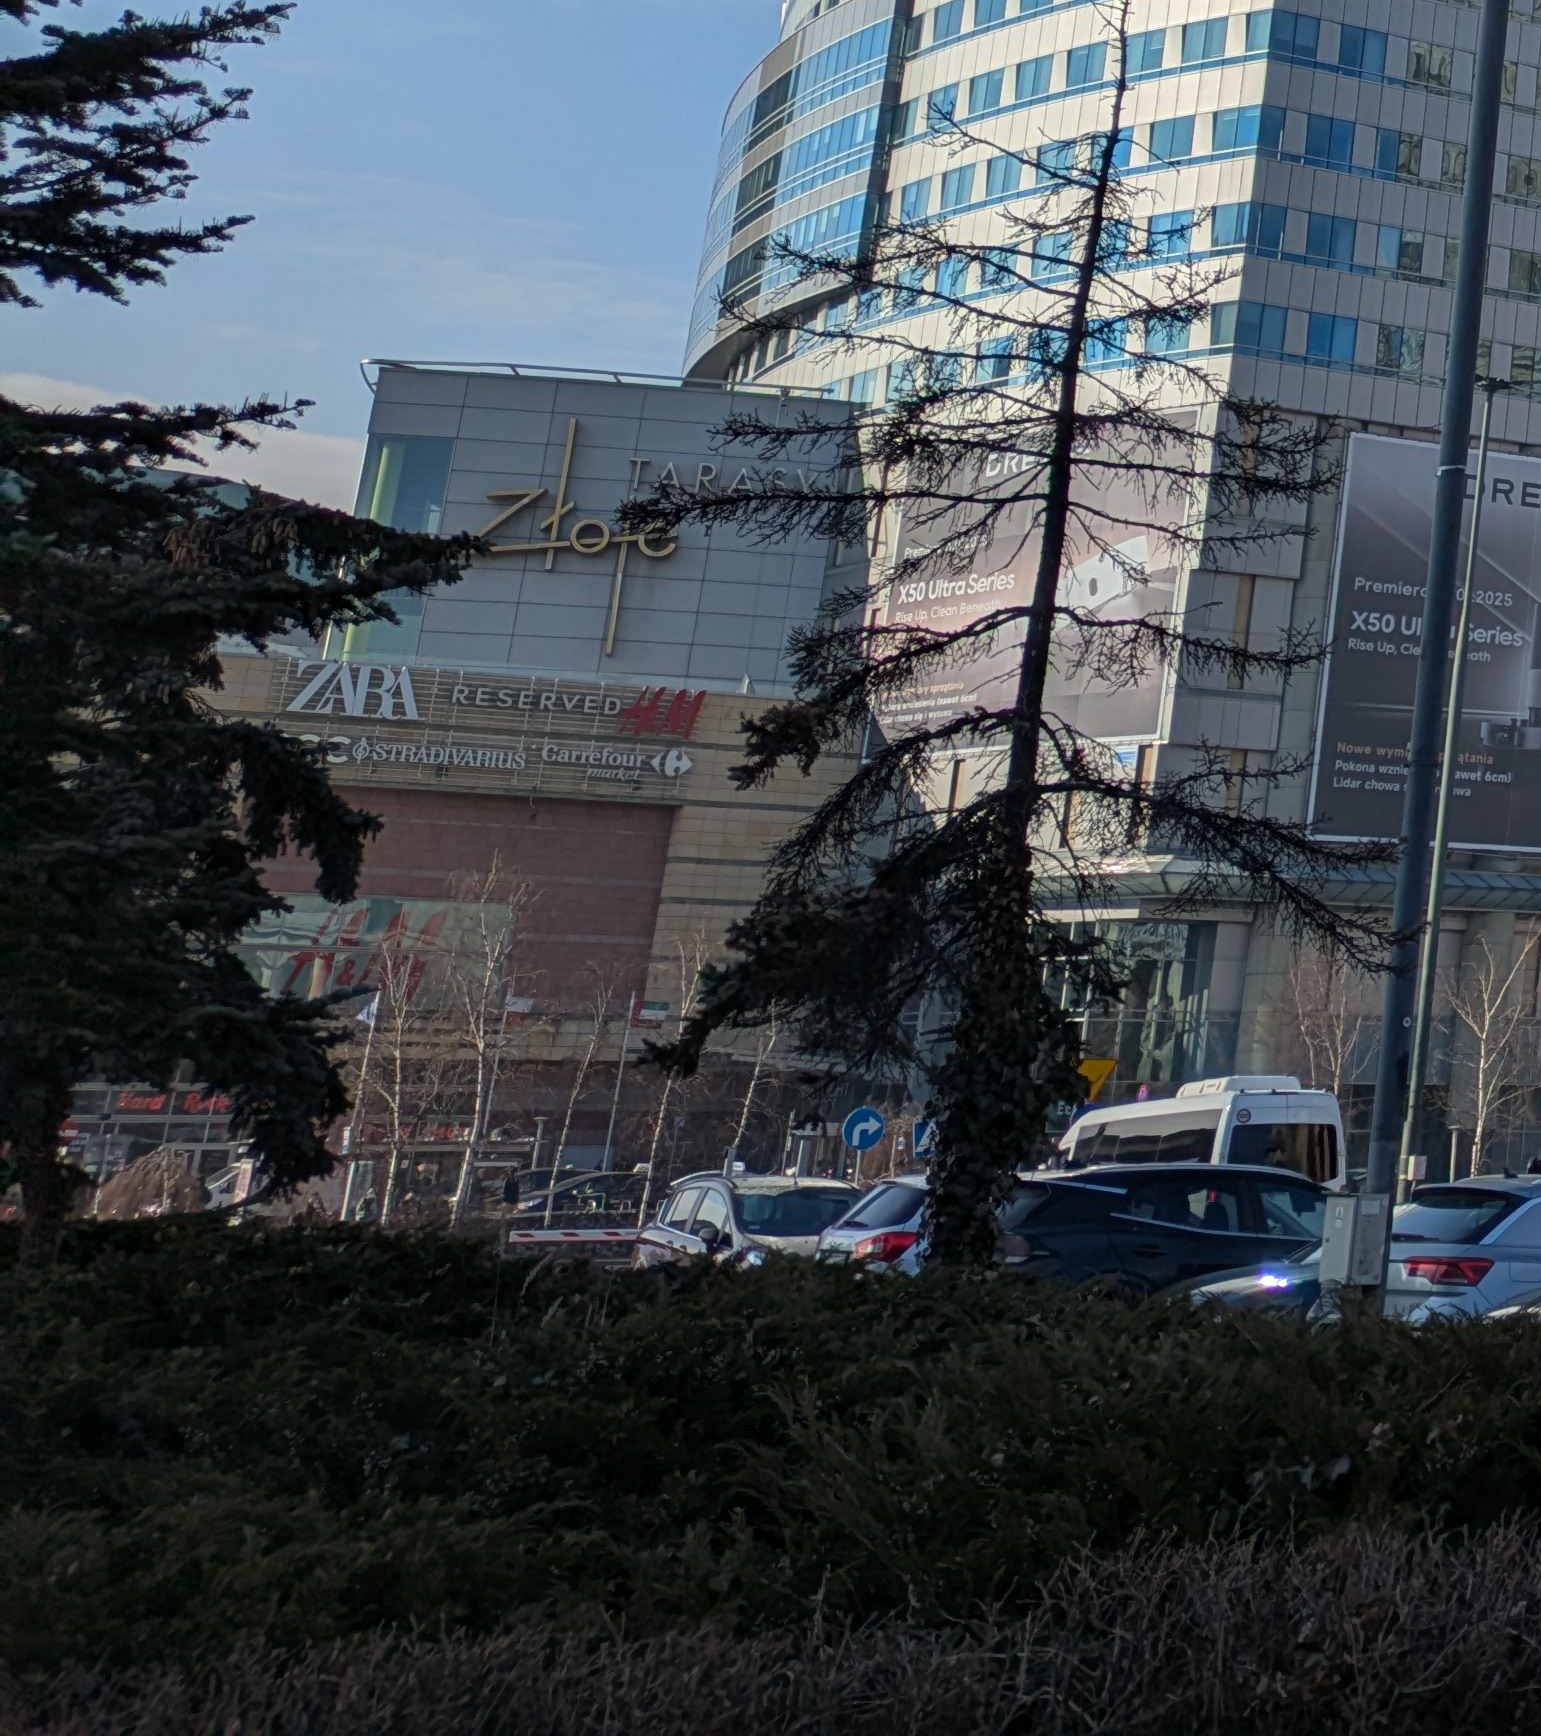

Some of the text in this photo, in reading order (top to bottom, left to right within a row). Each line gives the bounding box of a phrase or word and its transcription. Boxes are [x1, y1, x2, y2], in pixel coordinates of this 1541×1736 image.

[630, 457, 820, 494] TARASY
[898, 571, 1016, 605] X50 Ultra Series
[930, 603, 957, 619] Clean
[1350, 610, 1396, 633] X50
[1347, 637, 1375, 652] Rise
[1377, 640, 1398, 656] Up,
[287, 662, 425, 721] ZARA
[451, 685, 622, 715] RESERVED
[372, 742, 528, 771] STRADIVARIUS
[542, 743, 648, 768] Carrefour
[1336, 741, 1371, 755] Nowe
[586, 764, 641, 782] market
[1335, 759, 1375, 774] Pokona
[1484, 770, 1512, 783] 6cm)
[1333, 776, 1361, 789] Lidar
[1364, 778, 1400, 792] chowa
